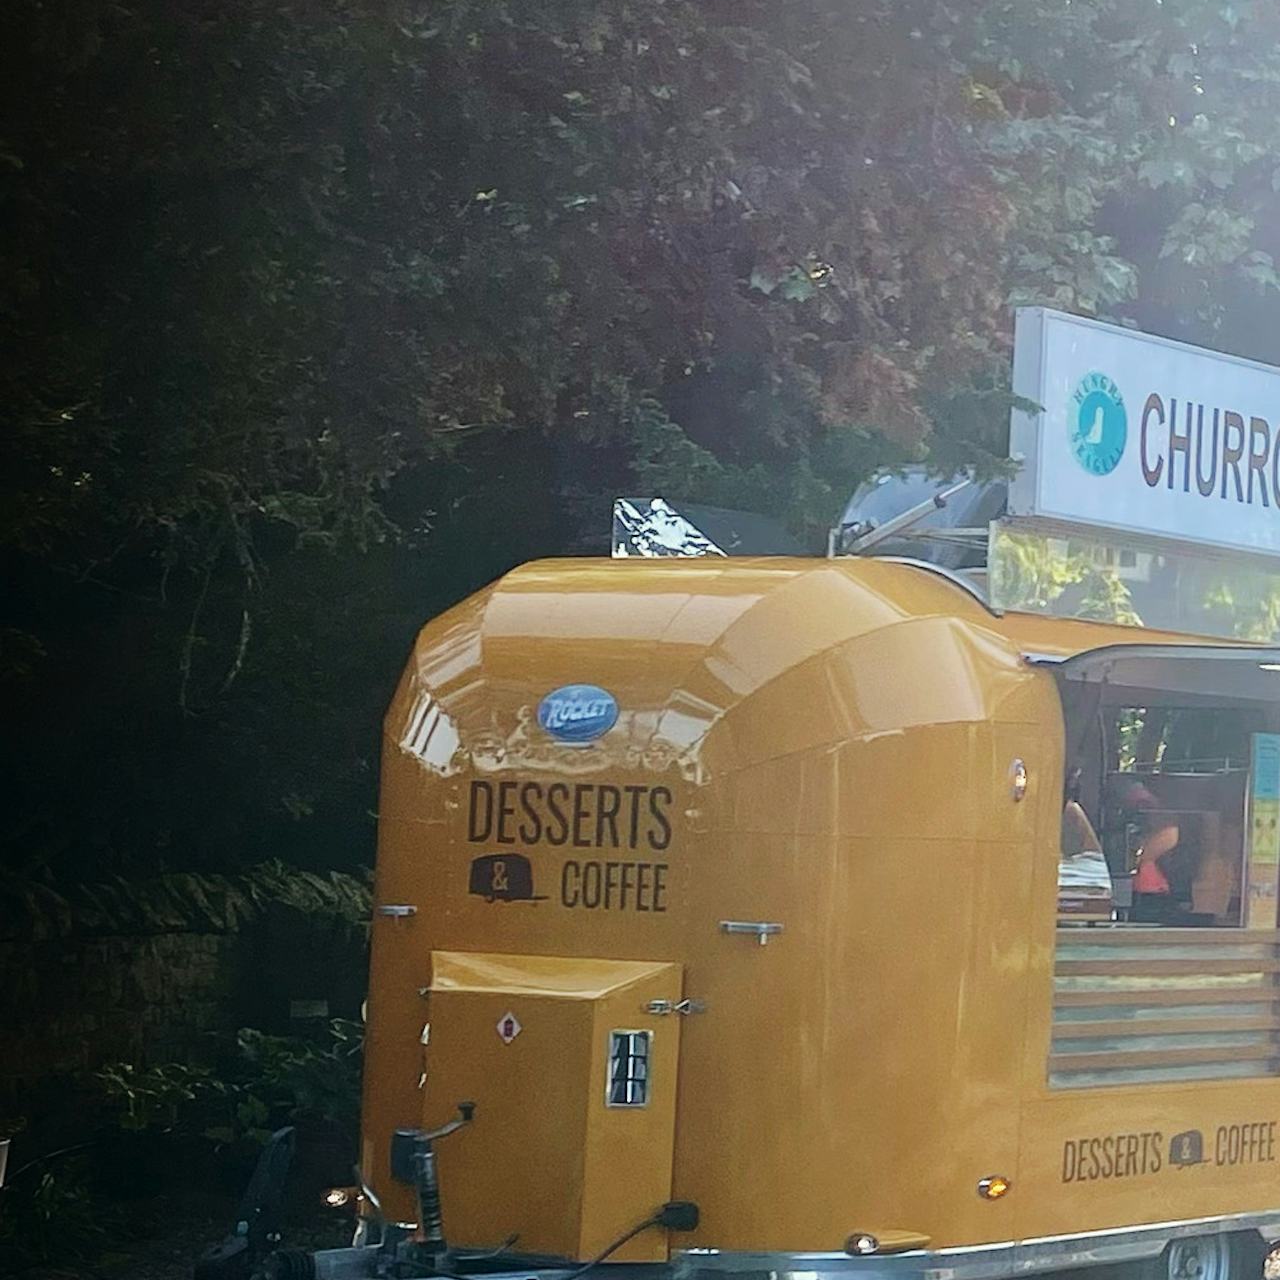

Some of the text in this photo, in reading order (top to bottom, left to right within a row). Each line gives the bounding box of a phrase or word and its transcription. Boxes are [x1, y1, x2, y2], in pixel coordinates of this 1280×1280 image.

[545, 699, 615, 728] ROCKET
[468, 780, 673, 850] DESSERTS
[491, 860, 669, 912] & COFFEE
[1062, 1131, 1163, 1183] DESSERTS
[1215, 1122, 1277, 1166] COFFEE
